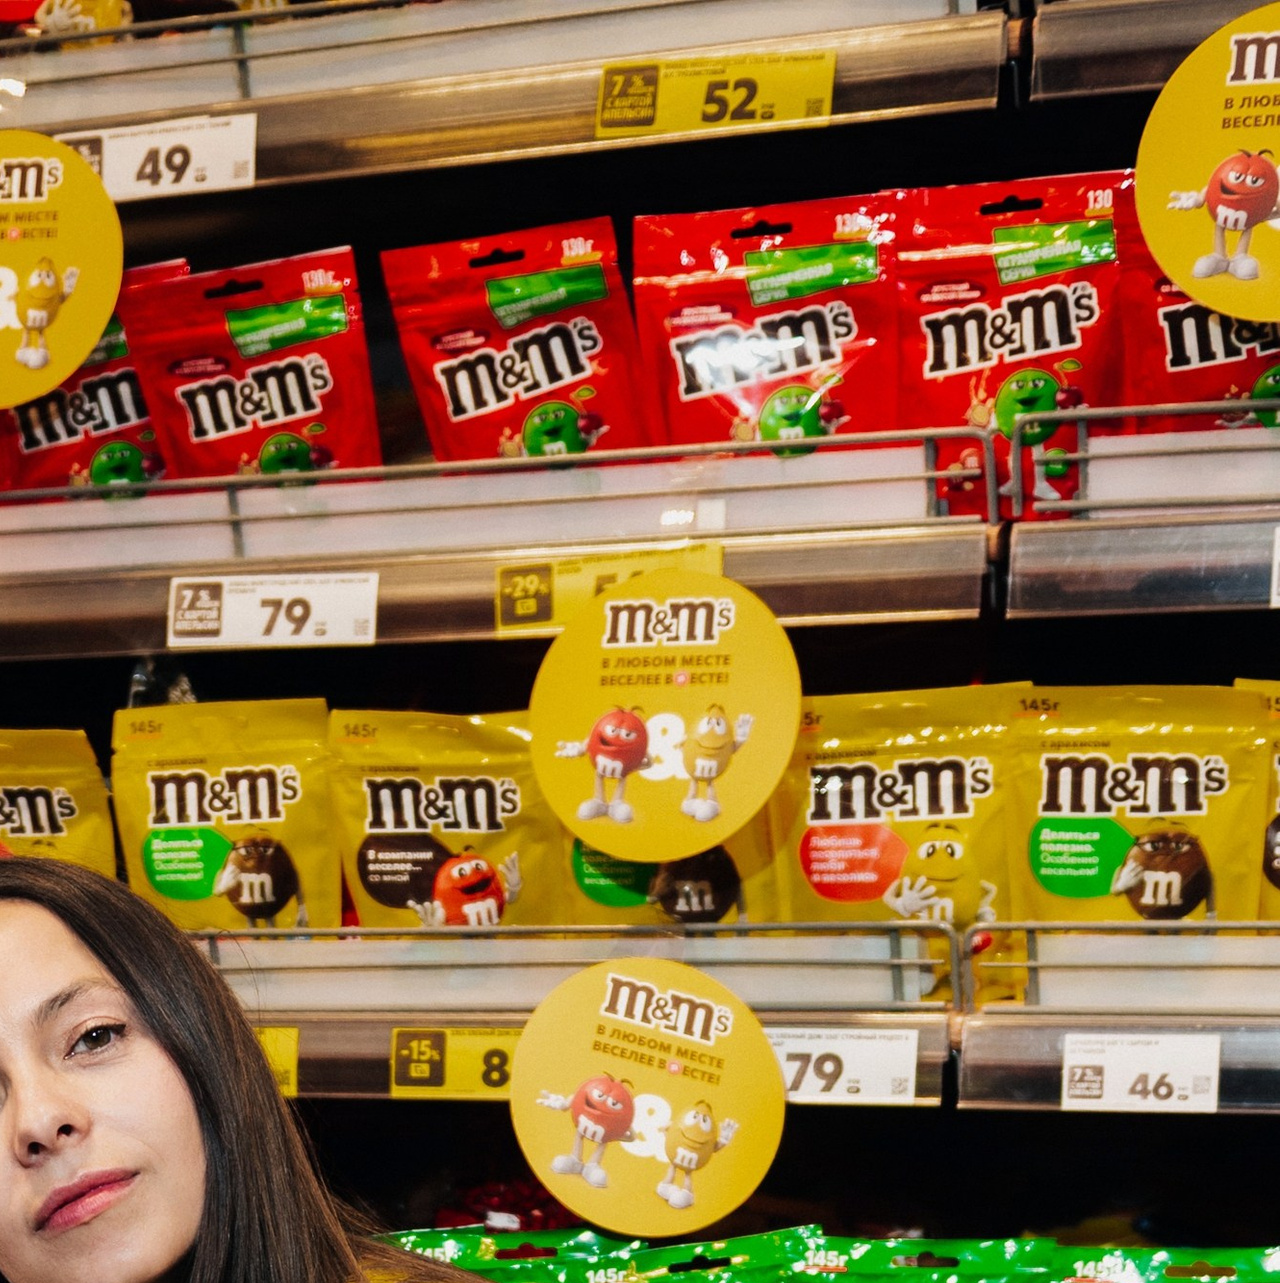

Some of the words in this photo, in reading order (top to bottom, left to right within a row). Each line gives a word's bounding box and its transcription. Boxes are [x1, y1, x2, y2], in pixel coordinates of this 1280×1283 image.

[702, 77, 760, 122] 52
[1224, 98, 1233, 109] В
[135, 146, 191, 186] 49
[920, 281, 1100, 380] m&m's
[435, 316, 604, 424] m&m's
[177, 352, 333, 444] m&m's
[259, 596, 313, 637] 79
[602, 598, 735, 649] m&m's
[600, 674, 662, 687] ВЕСЕЛЕЕ
[602, 657, 609, 669] В
[614, 656, 677, 669] ЛЮБОМ
[681, 654, 731, 668] МЕСТЕ
[1020, 697, 1060, 713] 145г
[148, 765, 302, 828] m&m's
[363, 776, 521, 833] m&m's
[806, 756, 994, 826] m&m's
[1037, 752, 1229, 817] m&m's
[238, 872, 276, 904] m
[1140, 870, 1183, 906] m
[600, 972, 734, 1046] m&m's
[592, 1040, 656, 1067] ВЕСЕЛЕЕ
[658, 1058, 721, 1086] ВЕСТЕ!
[596, 1024, 606, 1036] В
[610, 1028, 671, 1054] ЛЮБОМ
[676, 1045, 725, 1070] МЕСТЕ
[786, 1052, 845, 1093] 79
[1128, 1071, 1175, 1101] 46
[805, 1250, 849, 1266] 145г
